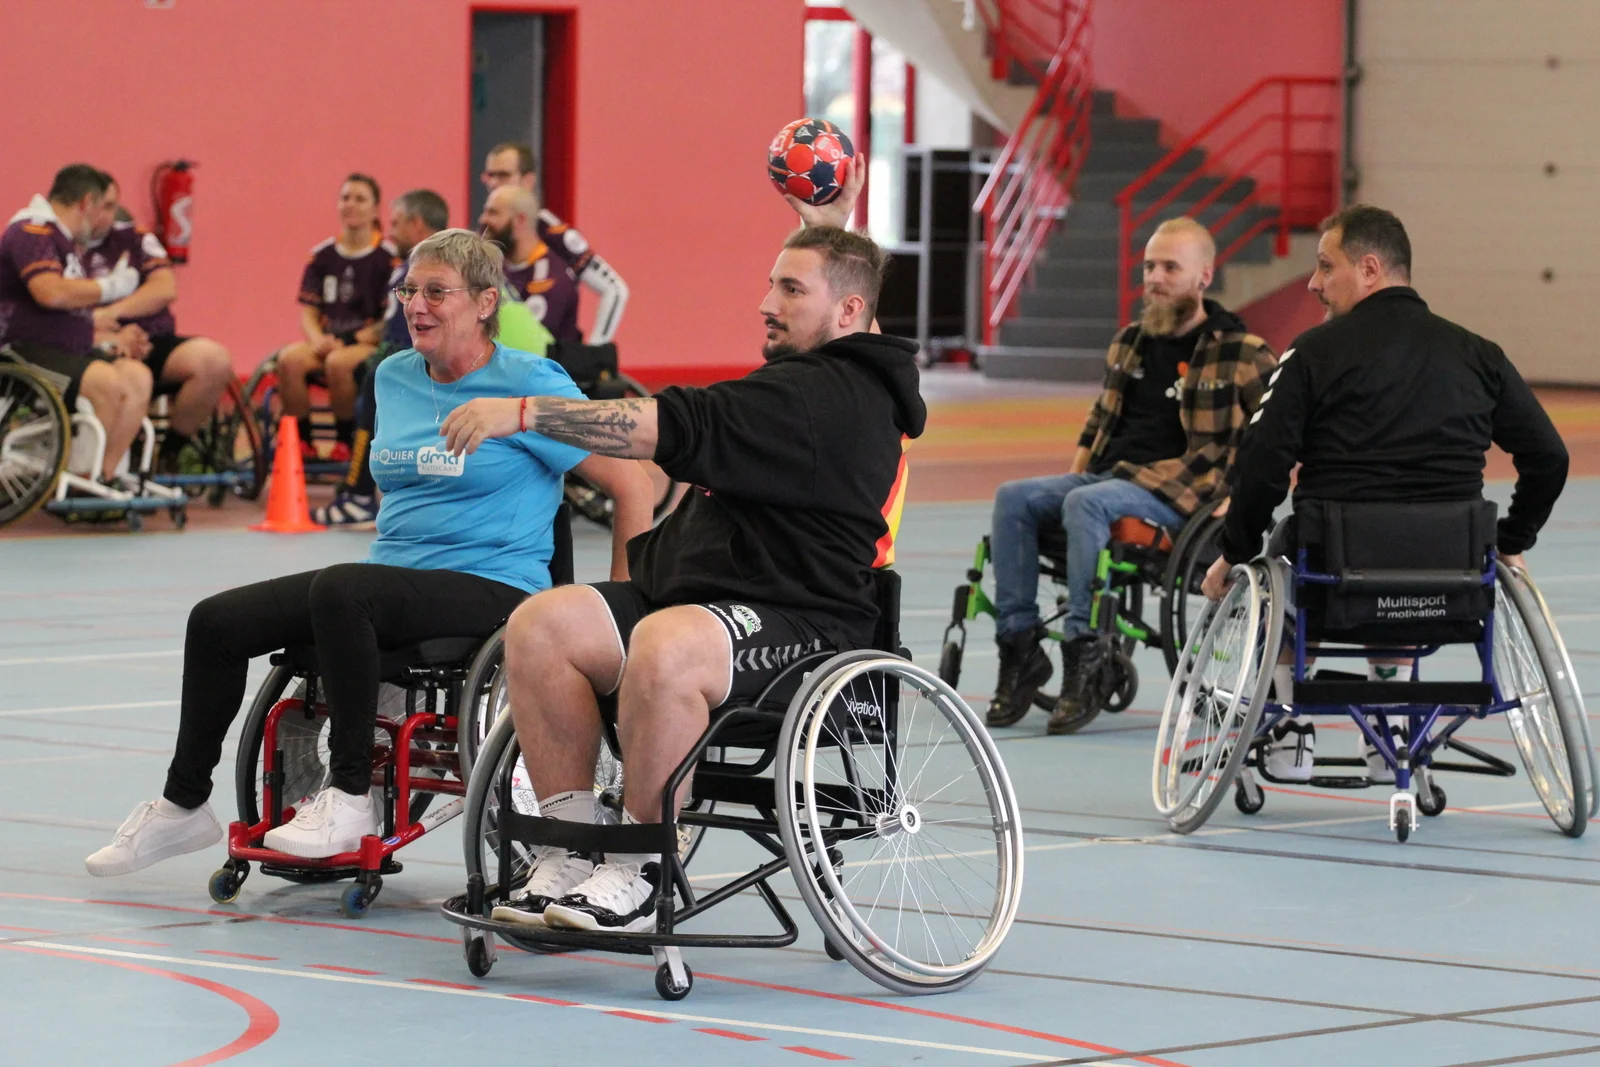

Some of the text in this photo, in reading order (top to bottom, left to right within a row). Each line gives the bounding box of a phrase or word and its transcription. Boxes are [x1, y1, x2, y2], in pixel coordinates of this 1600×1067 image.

[420, 450, 459, 465] dma
[1377, 594, 1447, 609] Multisport
[1387, 608, 1446, 619] motivation
